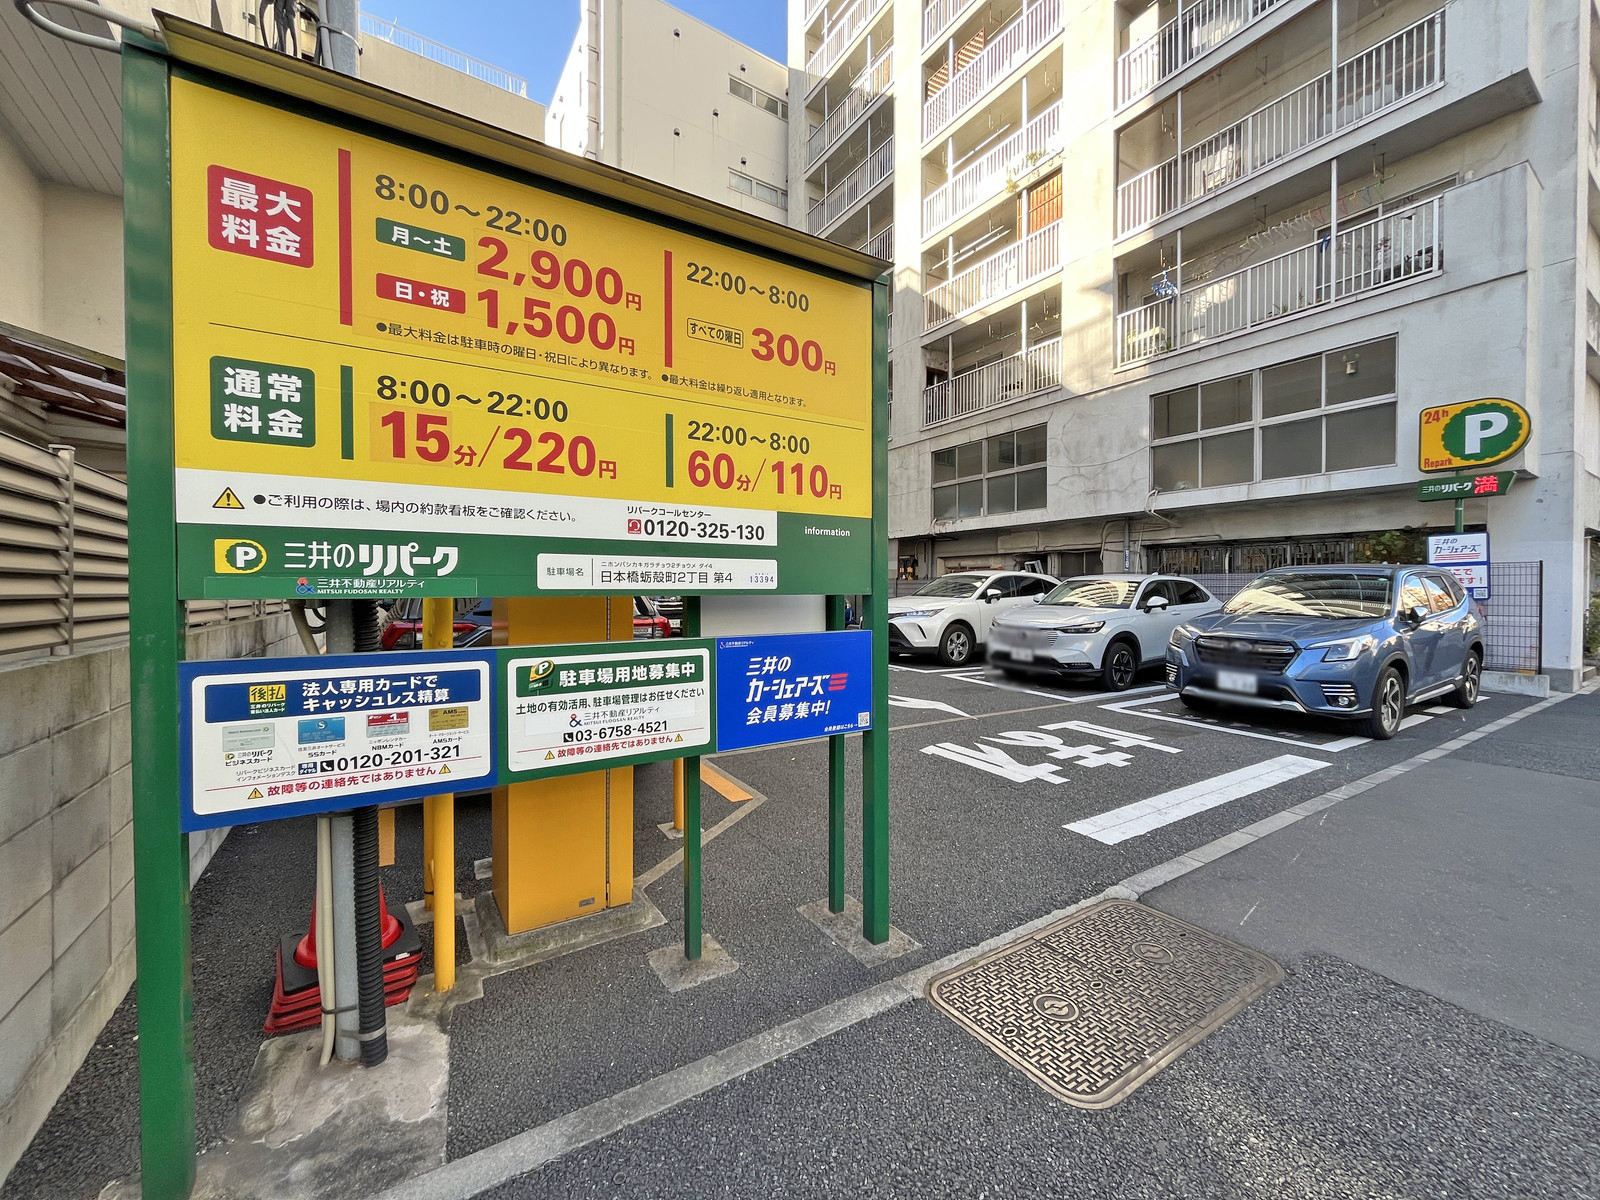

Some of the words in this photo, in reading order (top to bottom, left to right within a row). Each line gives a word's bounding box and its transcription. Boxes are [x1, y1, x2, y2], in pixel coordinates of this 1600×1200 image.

[221, 176, 302, 223] 最大
[221, 213, 302, 258] 料金
[476, 236, 642, 312] 2,900円
[394, 281, 450, 308] 日・祝
[477, 288, 635, 356] 1,500円
[689, 319, 742, 347] すべての曜日
[750, 327, 837, 377] 300円
[223, 366, 303, 404] 通常
[223, 403, 304, 439] 料金
[1424, 408, 1449, 425] 24h
[1464, 411, 1509, 456] P
[1423, 457, 1454, 469] Repark
[1422, 481, 1473, 495] 三井のリパーク
[1474, 475, 1499, 495] 満
[627, 505, 712, 519] リパークコールセンター
[643, 519, 766, 541] 0120-325-130
[804, 526, 851, 537] information
[1434, 538, 1458, 546] 三井の
[1434, 544, 1482, 555] カーシェアーズ
[235, 546, 258, 568] P
[283, 540, 460, 577] 三井のリパーク
[546, 566, 585, 577] 駐車場名
[601, 570, 709, 584] 日本橋蛎殻町2丁目
[713, 571, 734, 584] 第4
[749, 575, 775, 584] 13394
[317, 578, 426, 588] 三井不動産リアルティ
[538, 661, 549, 675] P
[559, 661, 697, 688] 駐車場用地募集中
[746, 655, 792, 676] 三井の
[251, 686, 285, 702] 後払
[302, 675, 438, 698] 法人専用カードで
[746, 674, 831, 703] カーシェアーズ
[302, 688, 450, 713] キャッシュレス精算
[515, 688, 705, 716] 土地の有効活用、駐車場管理はお任せください
[583, 706, 661, 721] 三井不動産リアルティ
[432, 736, 463, 745] AMSカード
[575, 720, 668, 742] 03-6758-4521
[307, 749, 338, 759] SSカード
[371, 742, 405, 752] NBMカード
[557, 735, 673, 759] 故障等の連絡先ではありません
[225, 757, 274, 768] ビジネスカード
[337, 744, 461, 772] 0120-201-321
[236, 765, 296, 778] リパークビジネスカード
[267, 765, 437, 798] 故障等の連絡先ではありません
[299, 767, 317, 775] ダイヤル
